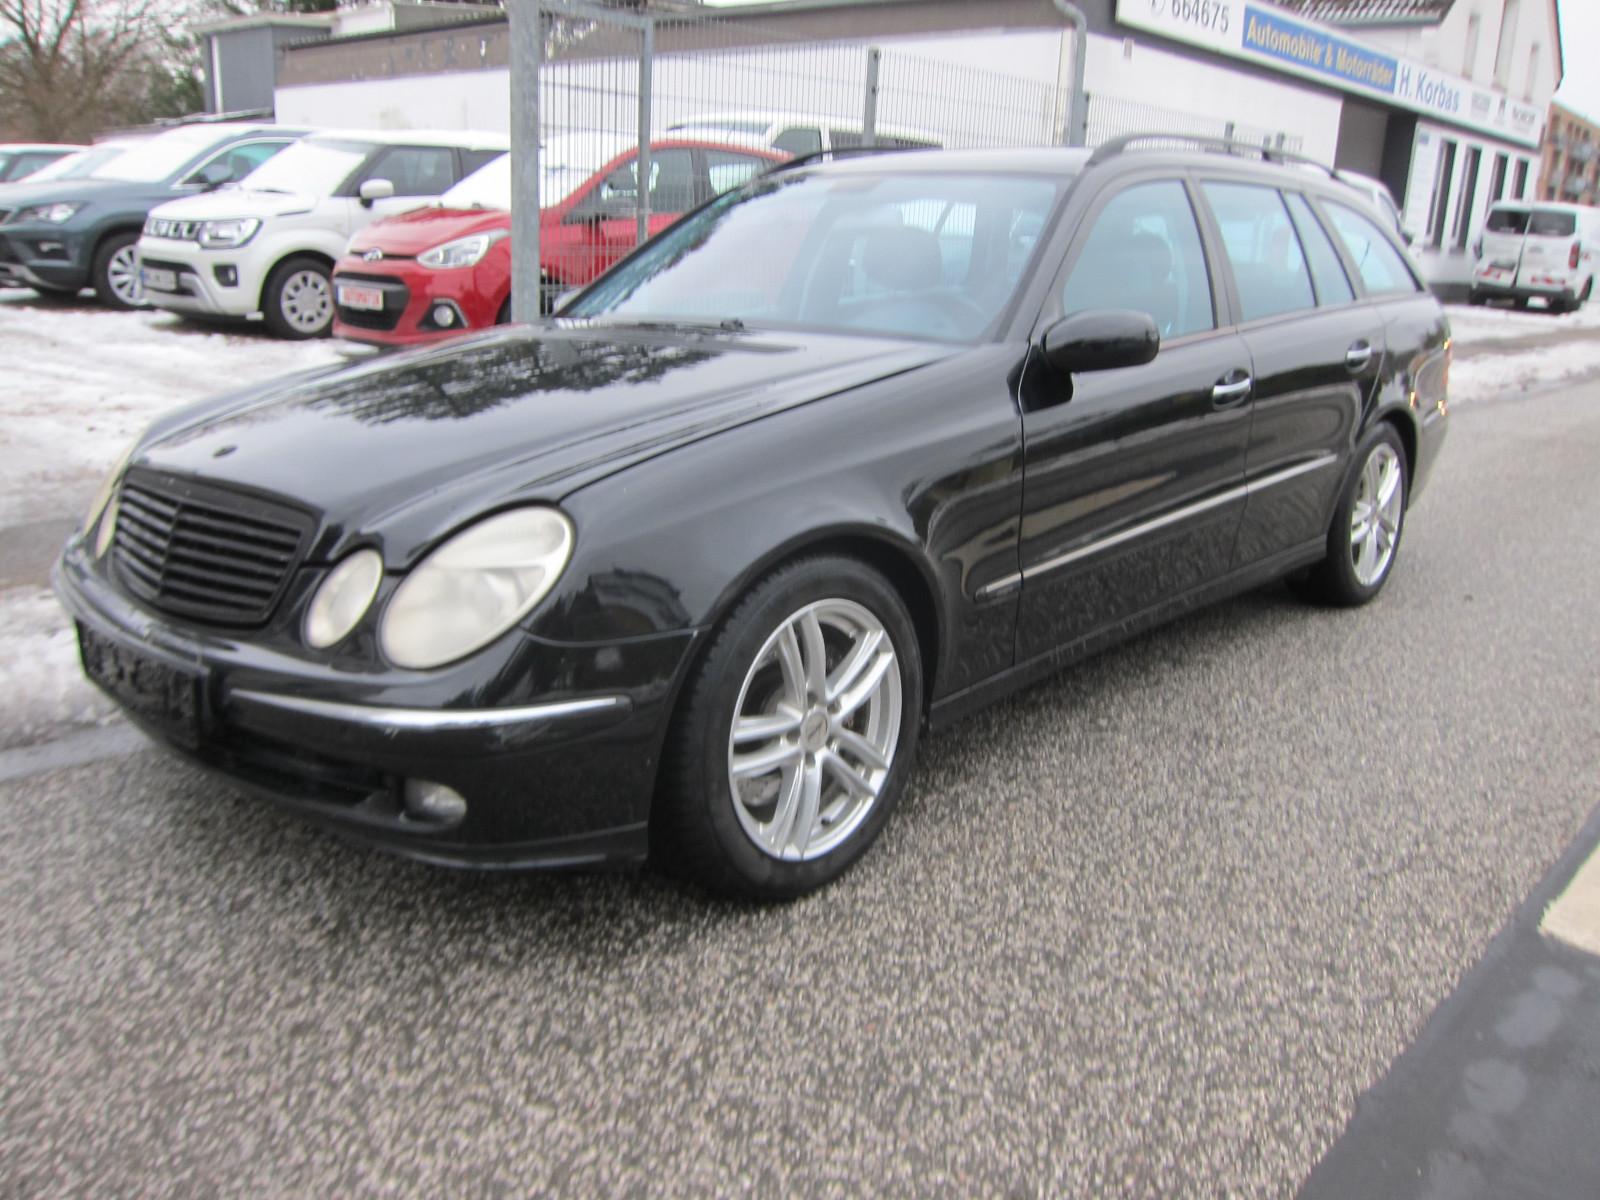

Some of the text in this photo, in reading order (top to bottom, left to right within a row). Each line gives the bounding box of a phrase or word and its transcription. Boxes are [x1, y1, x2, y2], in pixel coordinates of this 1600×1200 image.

[1247, 16, 1320, 64] Automobile
[1324, 43, 1333, 66] &
[1400, 63, 1412, 97] H.
[1416, 71, 1460, 112] Korbas
